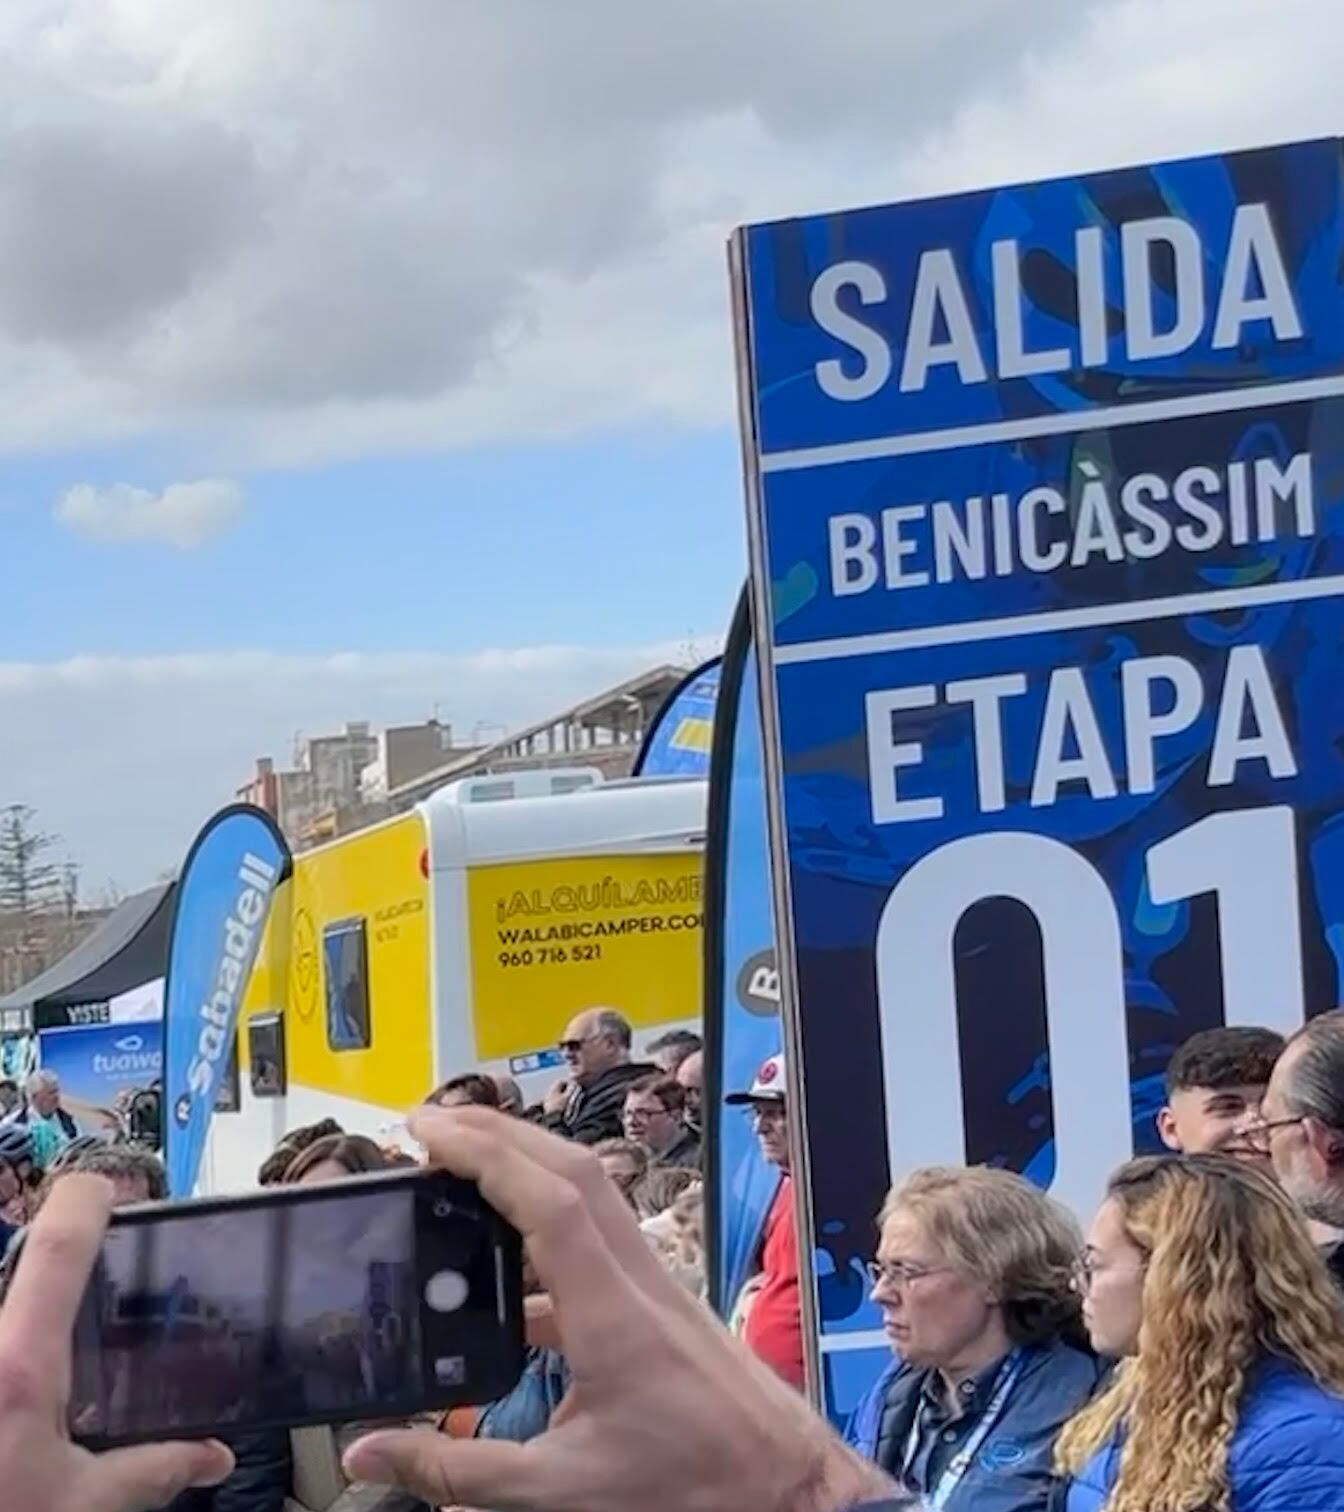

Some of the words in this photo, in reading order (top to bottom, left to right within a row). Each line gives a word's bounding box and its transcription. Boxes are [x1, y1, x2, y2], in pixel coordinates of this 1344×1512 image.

[810, 202, 1305, 401] SALIDA
[827, 451, 1314, 597] BENICÀSSIM
[864, 644, 1298, 826] ETAPA
[187, 852, 275, 1098] Sabadell
[498, 913, 706, 945] WALABICAMPER.CO
[498, 950, 533, 968] 960
[572, 944, 602, 962] 521
[748, 965, 782, 1002] B
